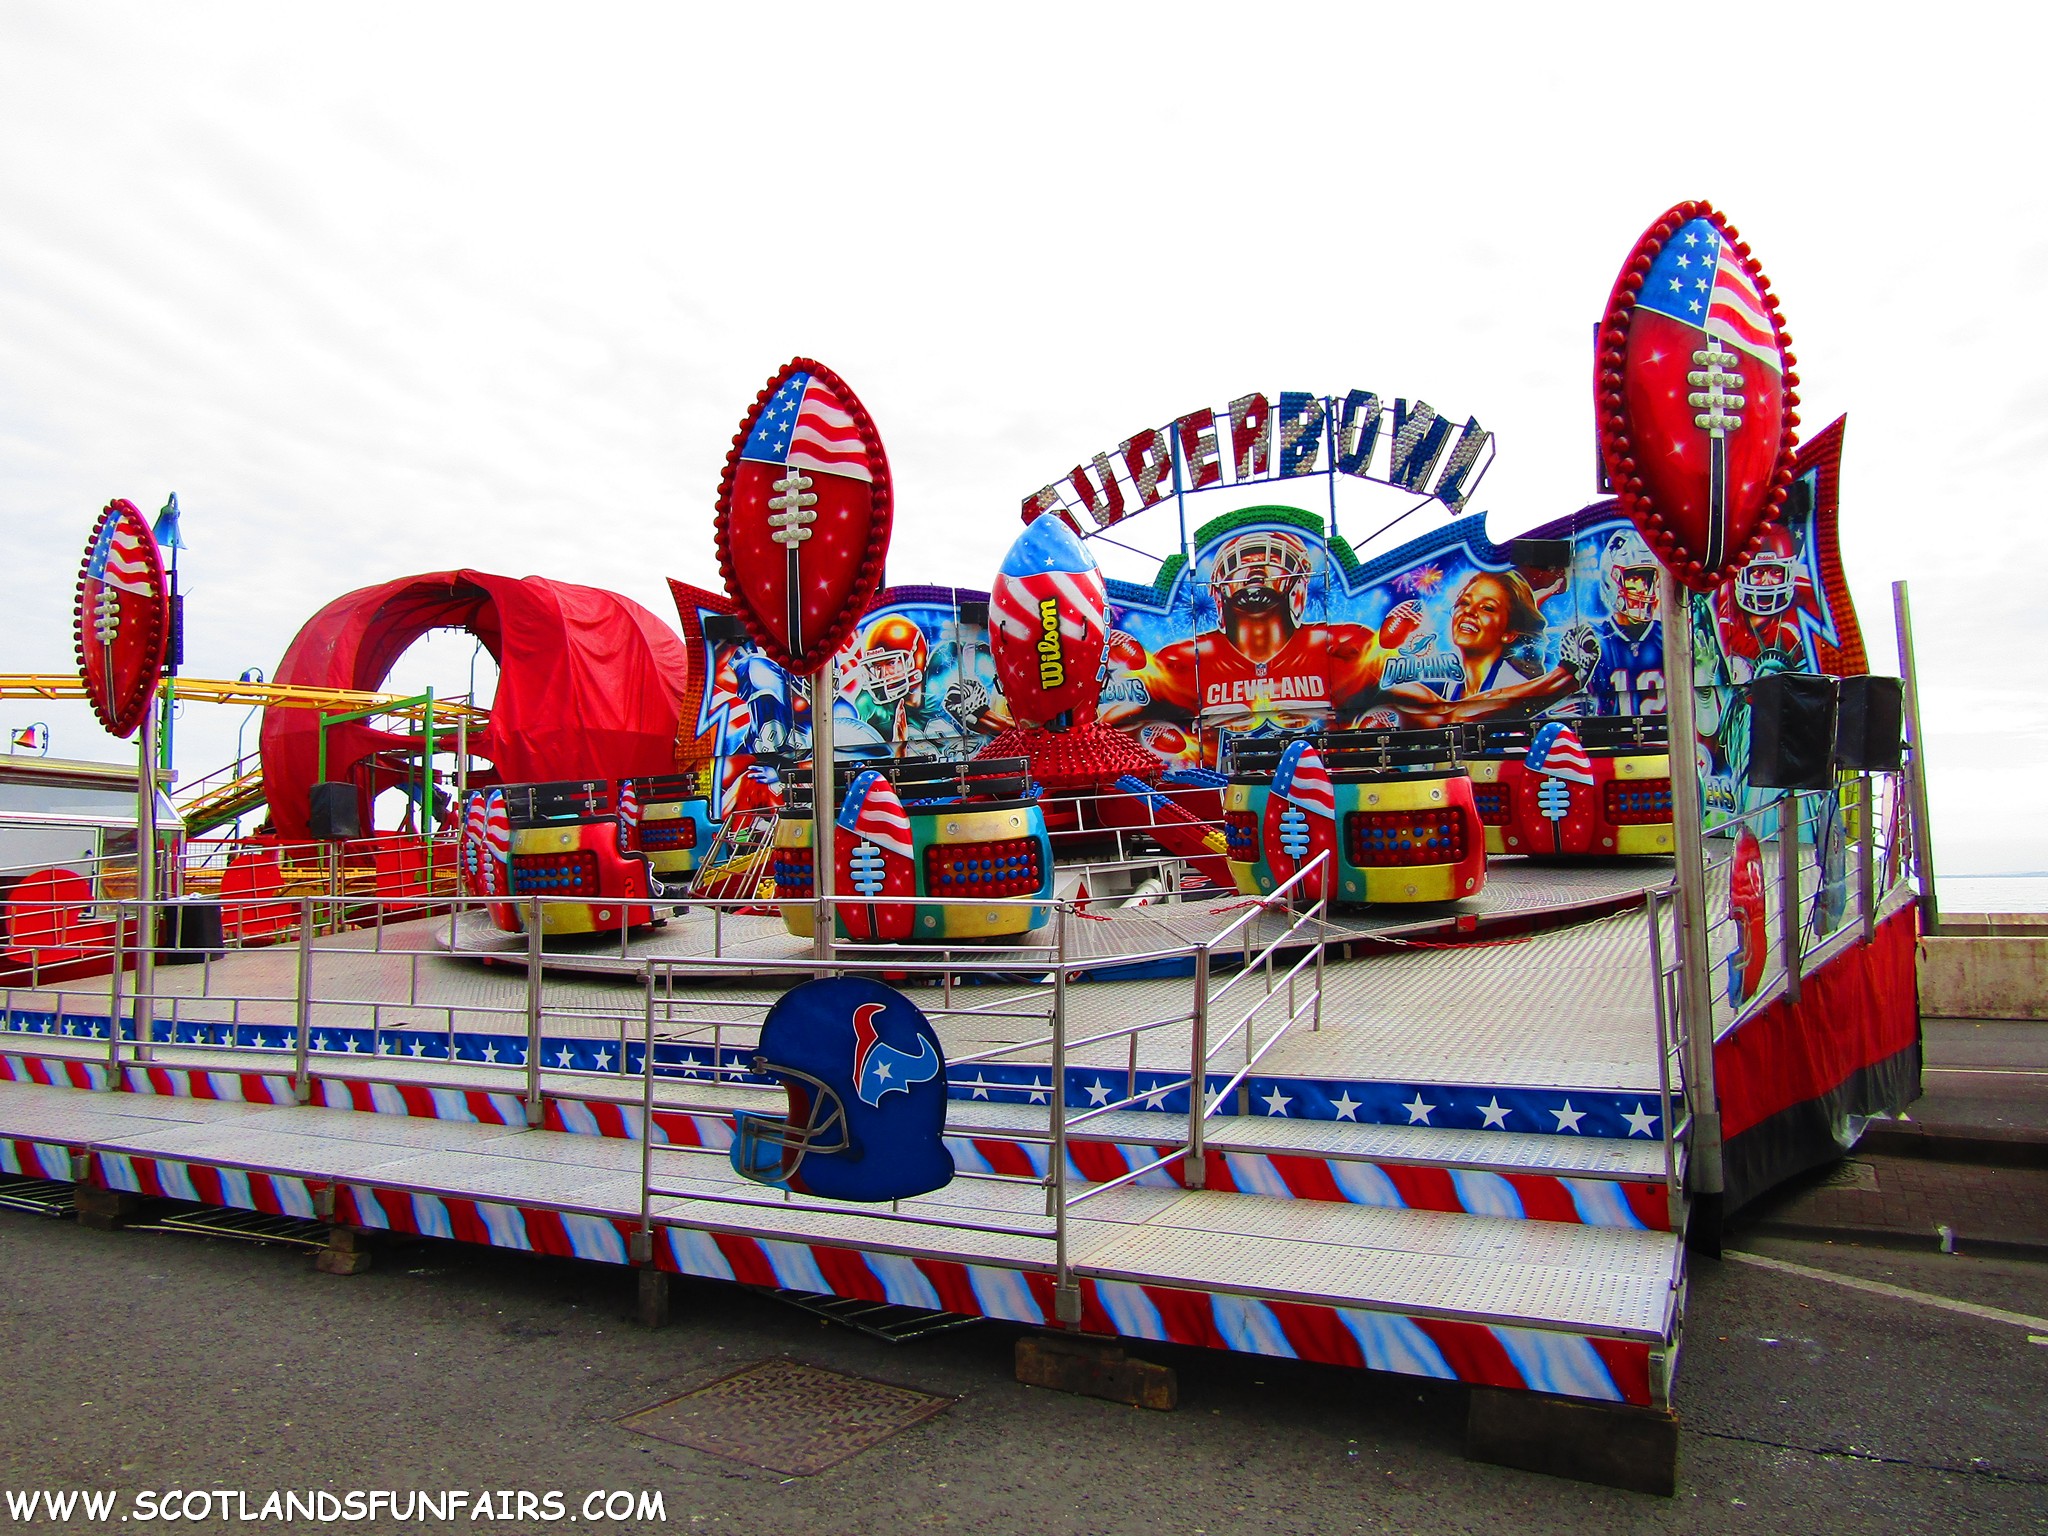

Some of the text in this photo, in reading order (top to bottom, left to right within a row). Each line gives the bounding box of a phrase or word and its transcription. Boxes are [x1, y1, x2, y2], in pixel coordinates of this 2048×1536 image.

[1037, 598, 1065, 690] Wilson
[1381, 653, 1465, 689] DOLPHINS
[1099, 678, 1149, 705] BOYS
[1206, 675, 1325, 704] CLEVELAND
[1610, 668, 1667, 716] 12
